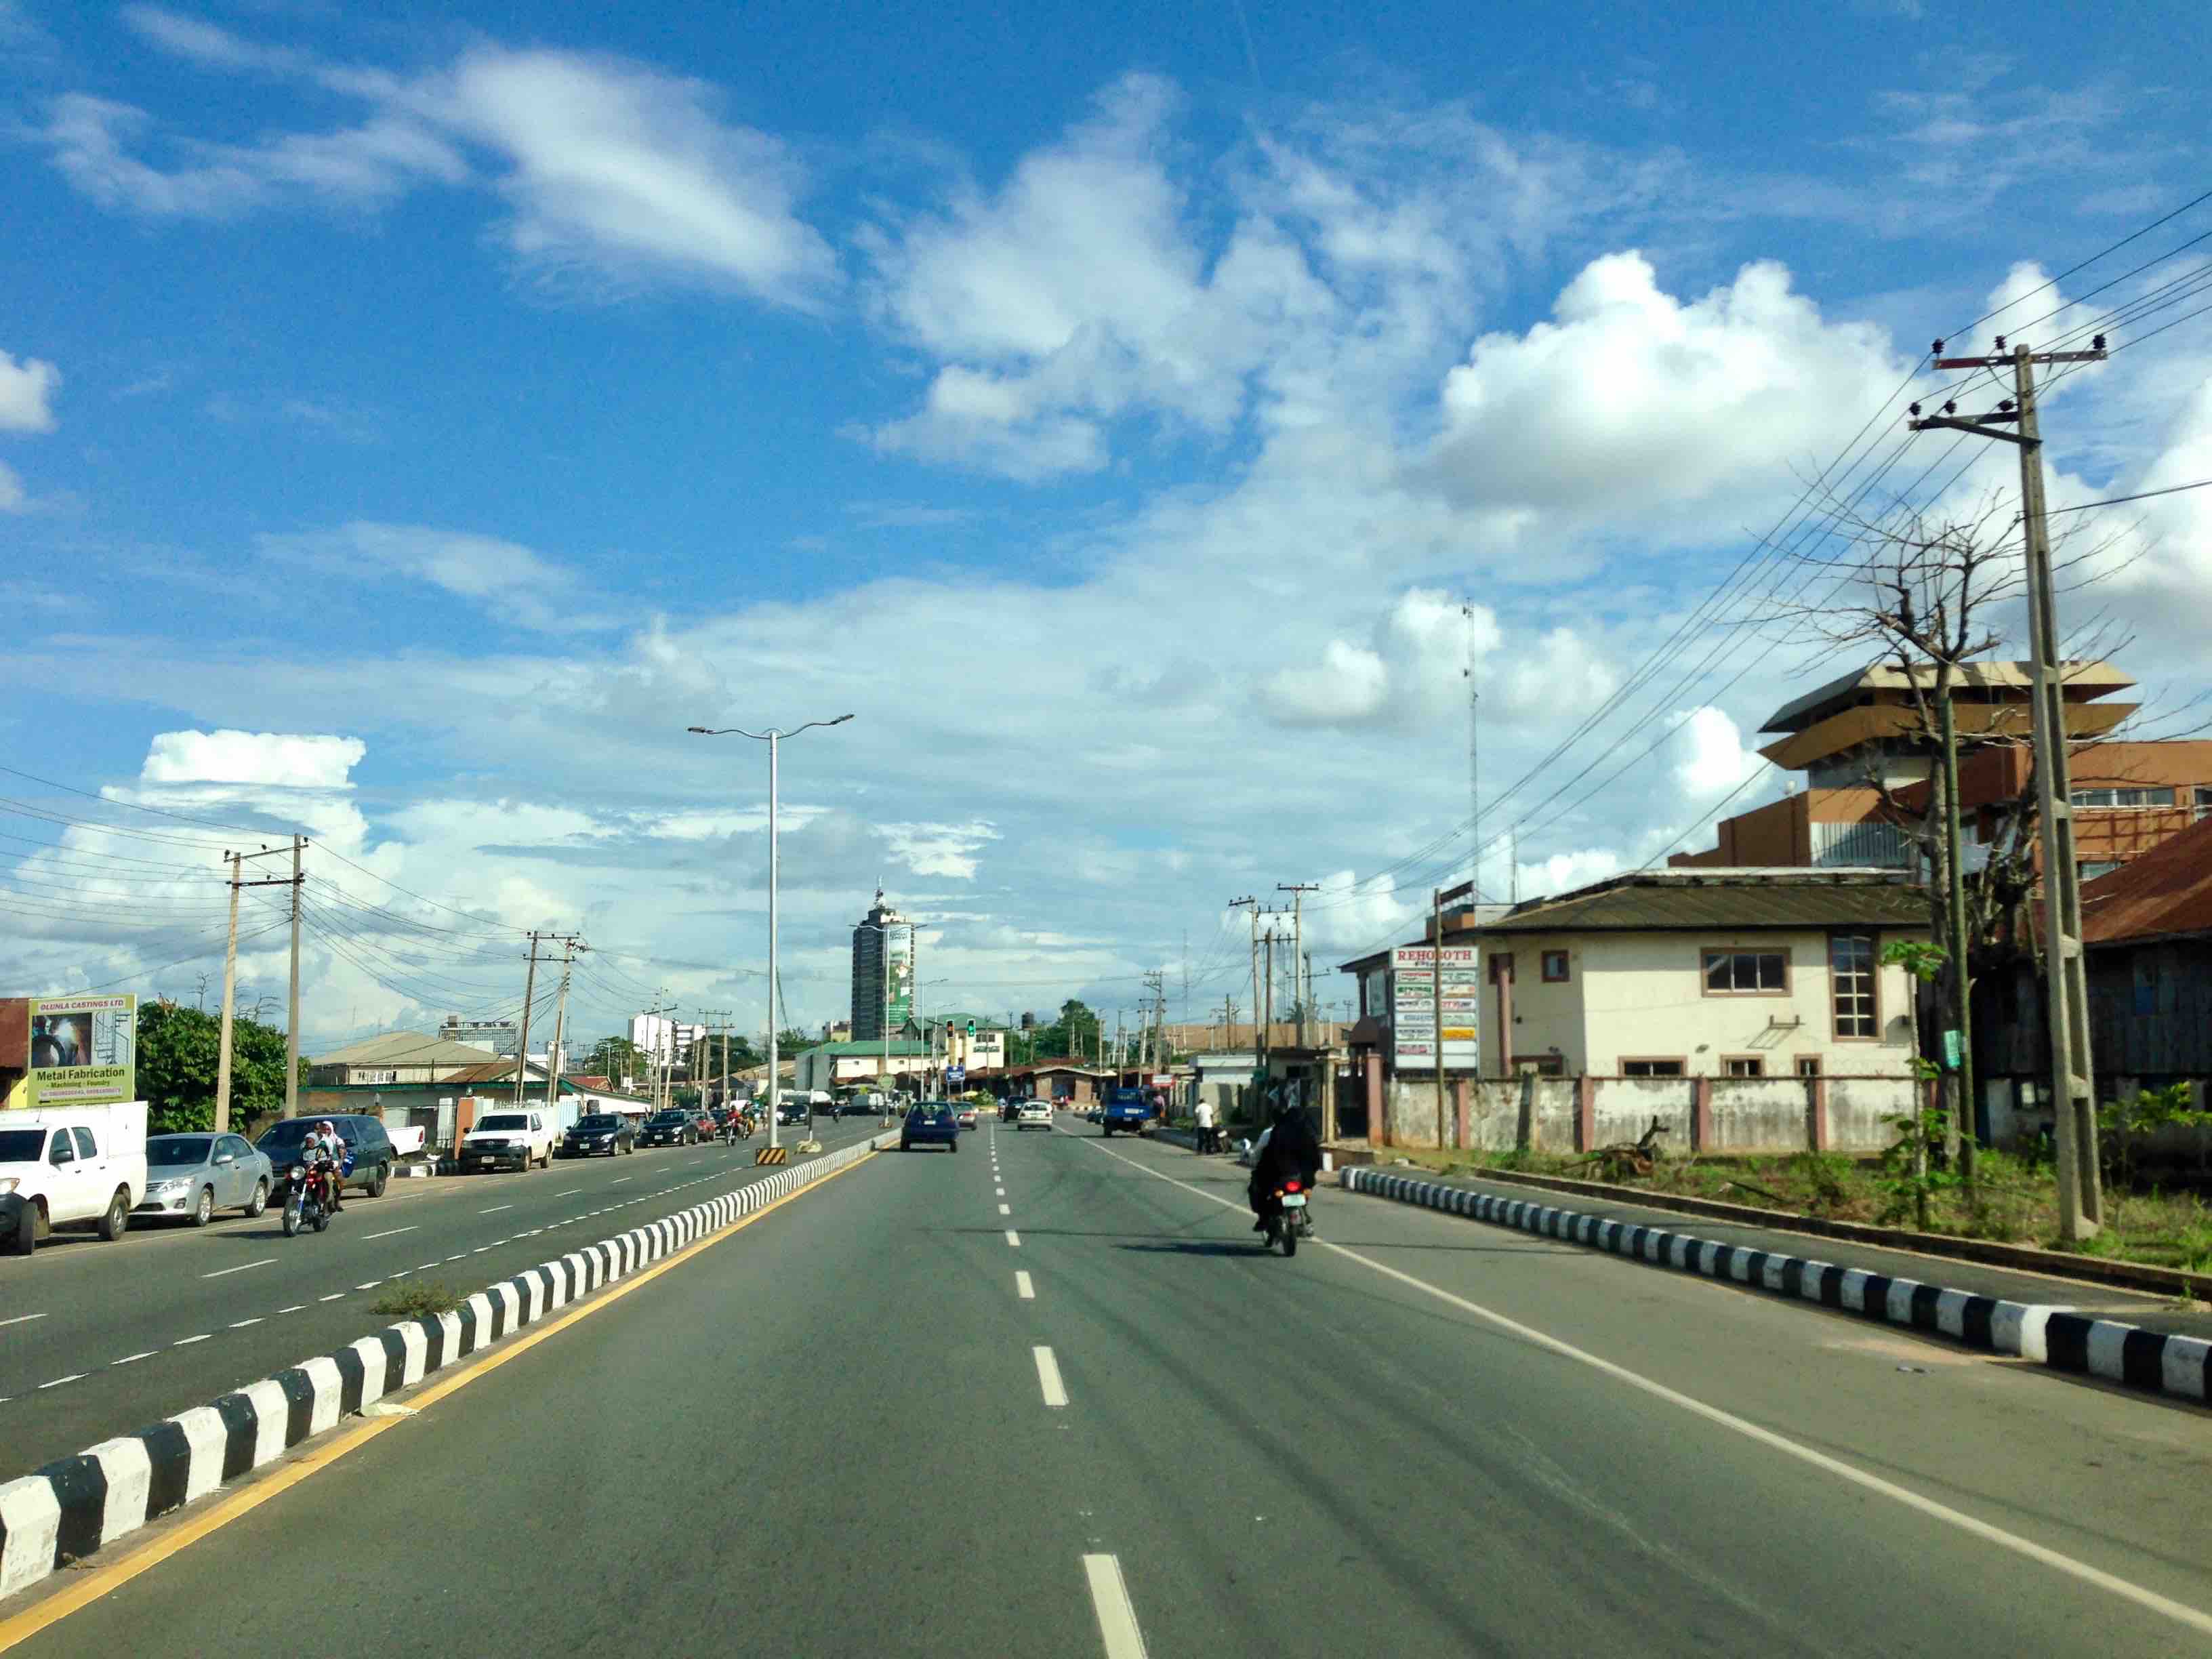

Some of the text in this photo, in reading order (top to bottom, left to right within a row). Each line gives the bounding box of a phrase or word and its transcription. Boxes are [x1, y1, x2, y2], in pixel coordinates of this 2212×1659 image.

[1398, 950, 1471, 960] REHOOTH
[71, 1000, 108, 1008] CASTINGS
[37, 1068, 125, 1081] Metal Fabrication
